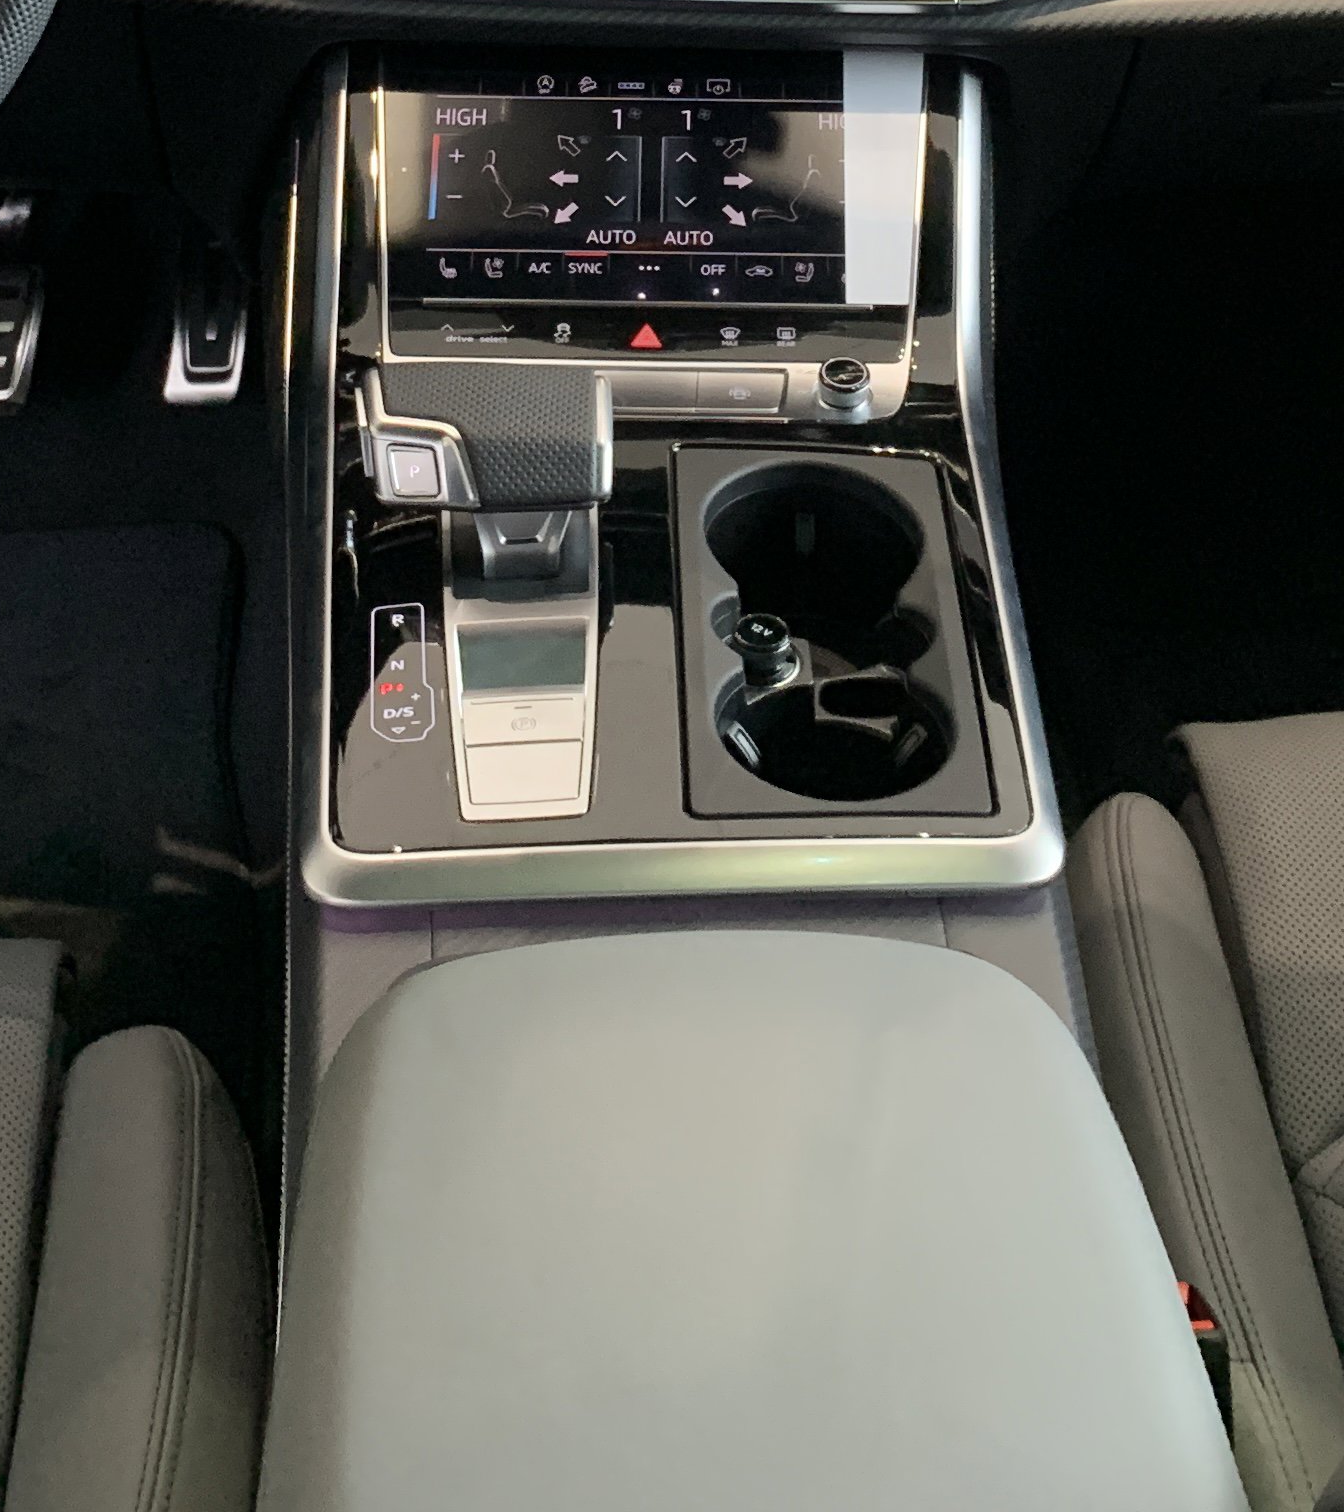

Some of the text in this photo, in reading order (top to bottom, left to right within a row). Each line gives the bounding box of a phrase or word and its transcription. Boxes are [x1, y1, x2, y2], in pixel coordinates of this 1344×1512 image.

[436, 108, 487, 126] HIGH
[612, 108, 622, 130] 1
[681, 110, 691, 131] 1
[586, 229, 636, 245] AUTO
[664, 230, 714, 246] AUTO
[528, 262, 552, 275] A/C
[567, 262, 603, 275] SYNC
[700, 264, 726, 276] OFF
[446, 335, 508, 344] drive select
[410, 464, 420, 478] P
[391, 614, 405, 627] R
[751, 623, 773, 636] 12V
[390, 660, 405, 670] N
[379, 682, 394, 695] P
[383, 706, 415, 719] D/S
